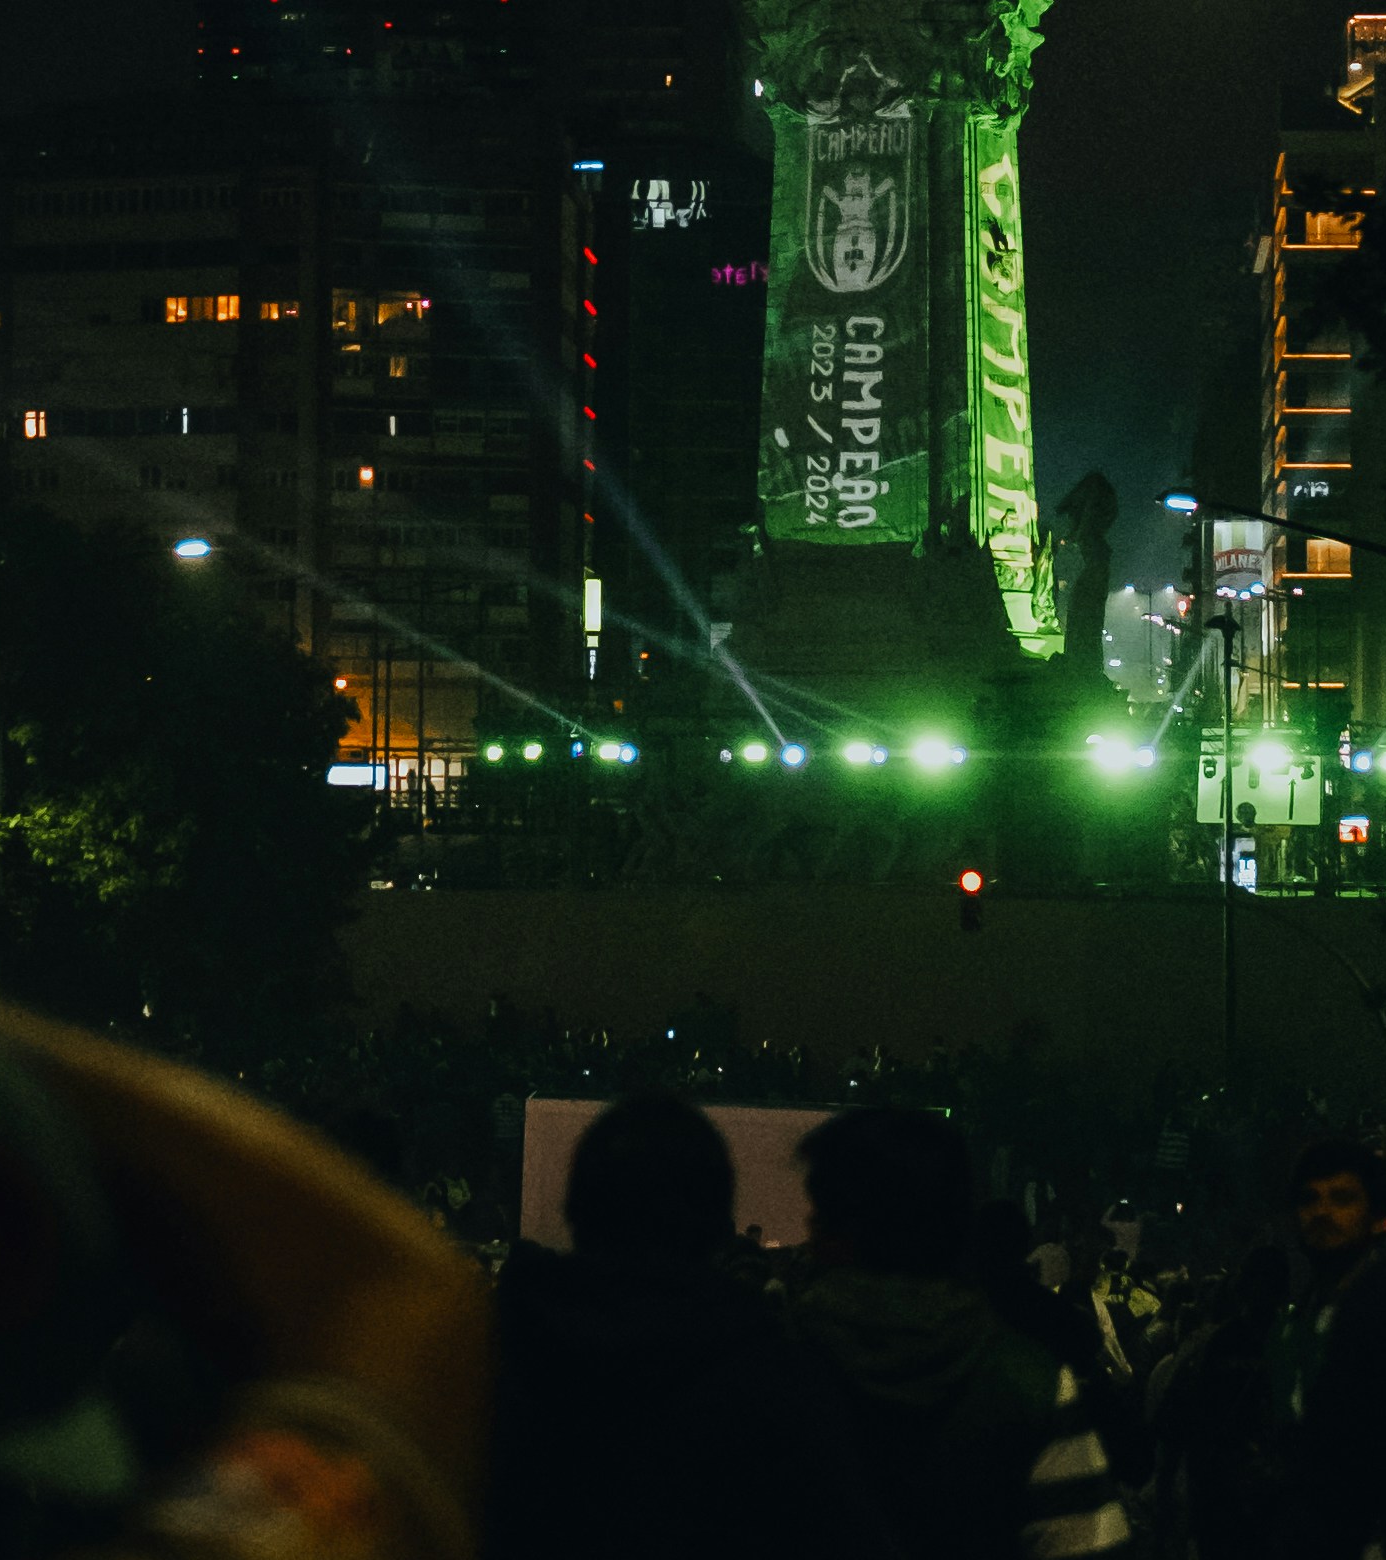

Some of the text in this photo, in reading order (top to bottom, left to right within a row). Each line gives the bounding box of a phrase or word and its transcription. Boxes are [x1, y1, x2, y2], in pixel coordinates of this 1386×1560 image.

[810, 323, 836, 402] 2023
[835, 316, 890, 528] CAMPEÃO
[805, 455, 831, 525] 2024
